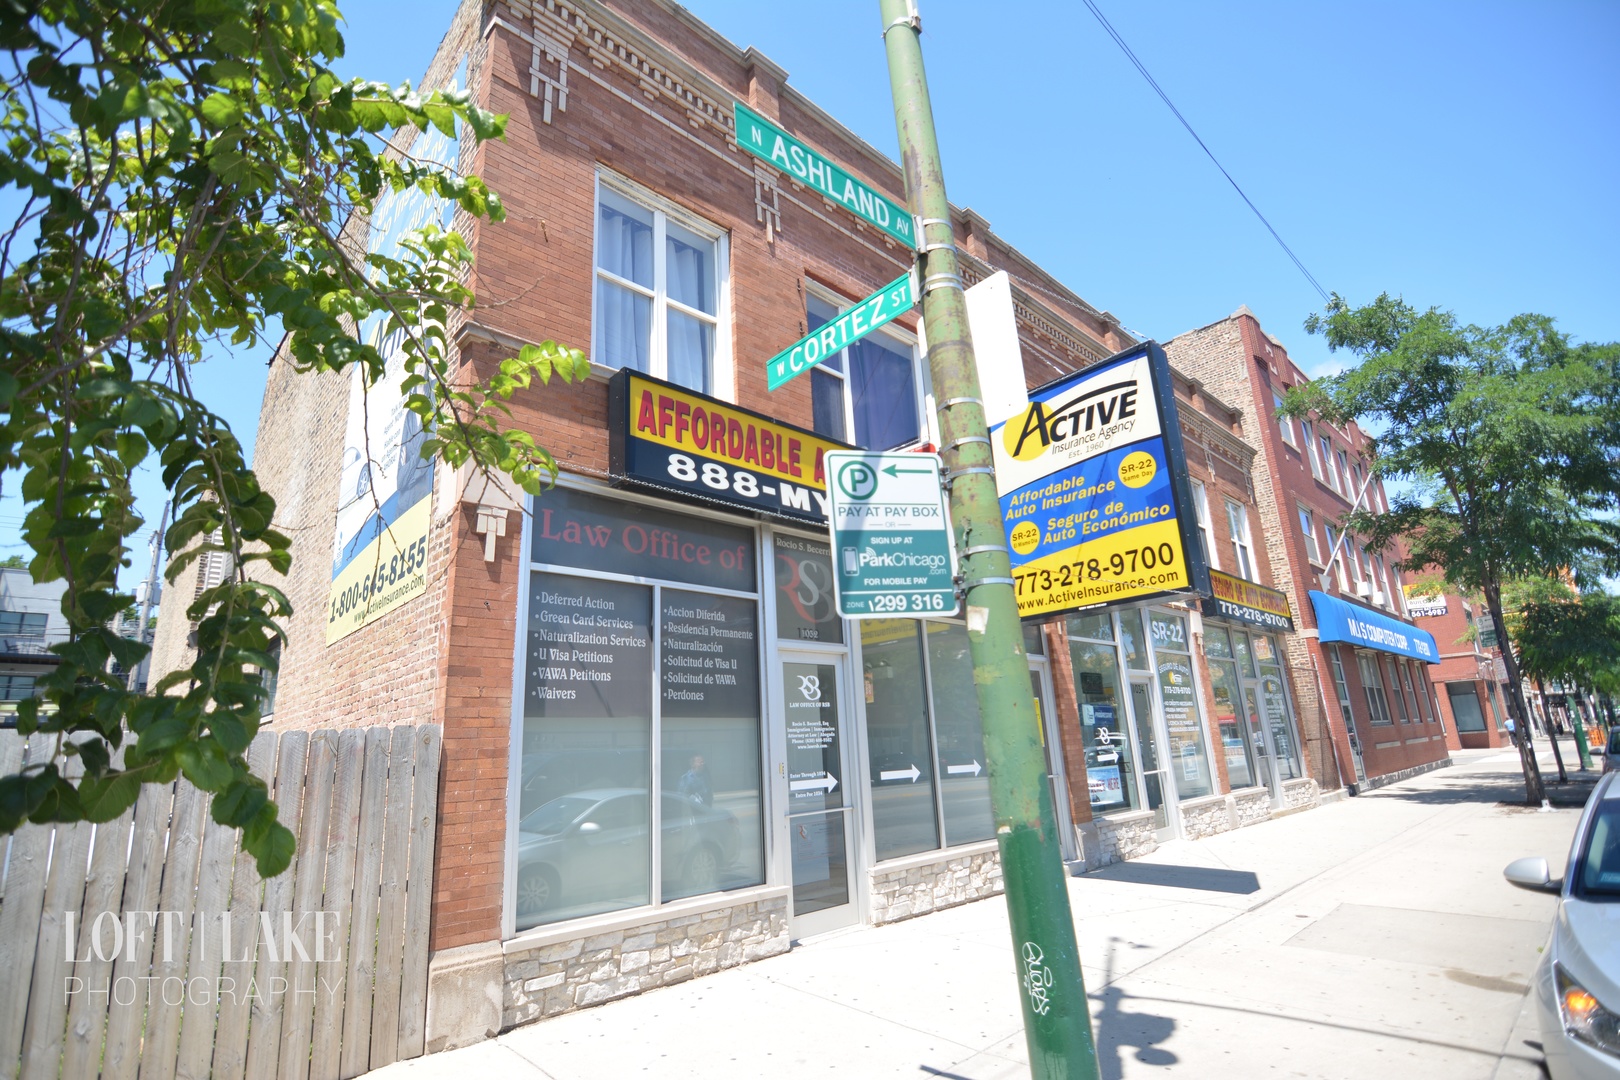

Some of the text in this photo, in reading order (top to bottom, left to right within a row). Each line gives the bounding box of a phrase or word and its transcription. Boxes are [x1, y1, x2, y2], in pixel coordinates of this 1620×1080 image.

[752, 125, 909, 236] N ASHLAND AV
[776, 286, 907, 377] W CORTEZ ST
[1012, 384, 1138, 458] ACTIVE
[638, 389, 802, 478] AFFORDABLE
[1051, 419, 1136, 455] Insurance Agency
[1068, 441, 1104, 459] Est. 1960
[1121, 459, 1152, 474] SR-22
[667, 453, 828, 520] 888-MY
[1123, 473, 1139, 482] Same
[1005, 480, 1116, 520] Auto Insurance
[1010, 476, 1085, 507] Affordable
[838, 506, 939, 517] PAY AT PAY BOX
[1047, 502, 1124, 531] Seguro de
[1043, 504, 1170, 545] Auto Económico
[541, 508, 745, 570] Law Office of
[871, 537, 890, 545] SIGN
[891, 537, 902, 545] UP
[1012, 528, 1037, 542] SR-22
[776, 537, 831, 556] Rocio S. Becerri
[859, 552, 946, 569] ParkChicago
[1014, 542, 1174, 597] 773-278-9700
[330, 535, 427, 623] 1-800-645-8155
[864, 578, 880, 586] FOR
[1017, 568, 1179, 610] www.ActiveInsurance.com
[541, 591, 615, 610] Deferred Action
[911, 594, 944, 611] 316
[540, 610, 633, 629] Green Card Services
[667, 605, 726, 622] Accion Diferida
[1219, 601, 1288, 628] 773-278-9700
[539, 629, 646, 647] Naturalization Services
[668, 621, 753, 639] Residencia Permanente
[1151, 620, 1184, 643] SR-22
[667, 638, 723, 652] Naturalización
[539, 647, 614, 663] U Visa Petitions
[667, 654, 737, 669] Solicitud de Visa U
[538, 667, 611, 681] VAWA Petitions
[667, 671, 737, 685] Solicitud de VAWA
[537, 686, 576, 699] Waivers
[667, 688, 704, 700] Perdones
